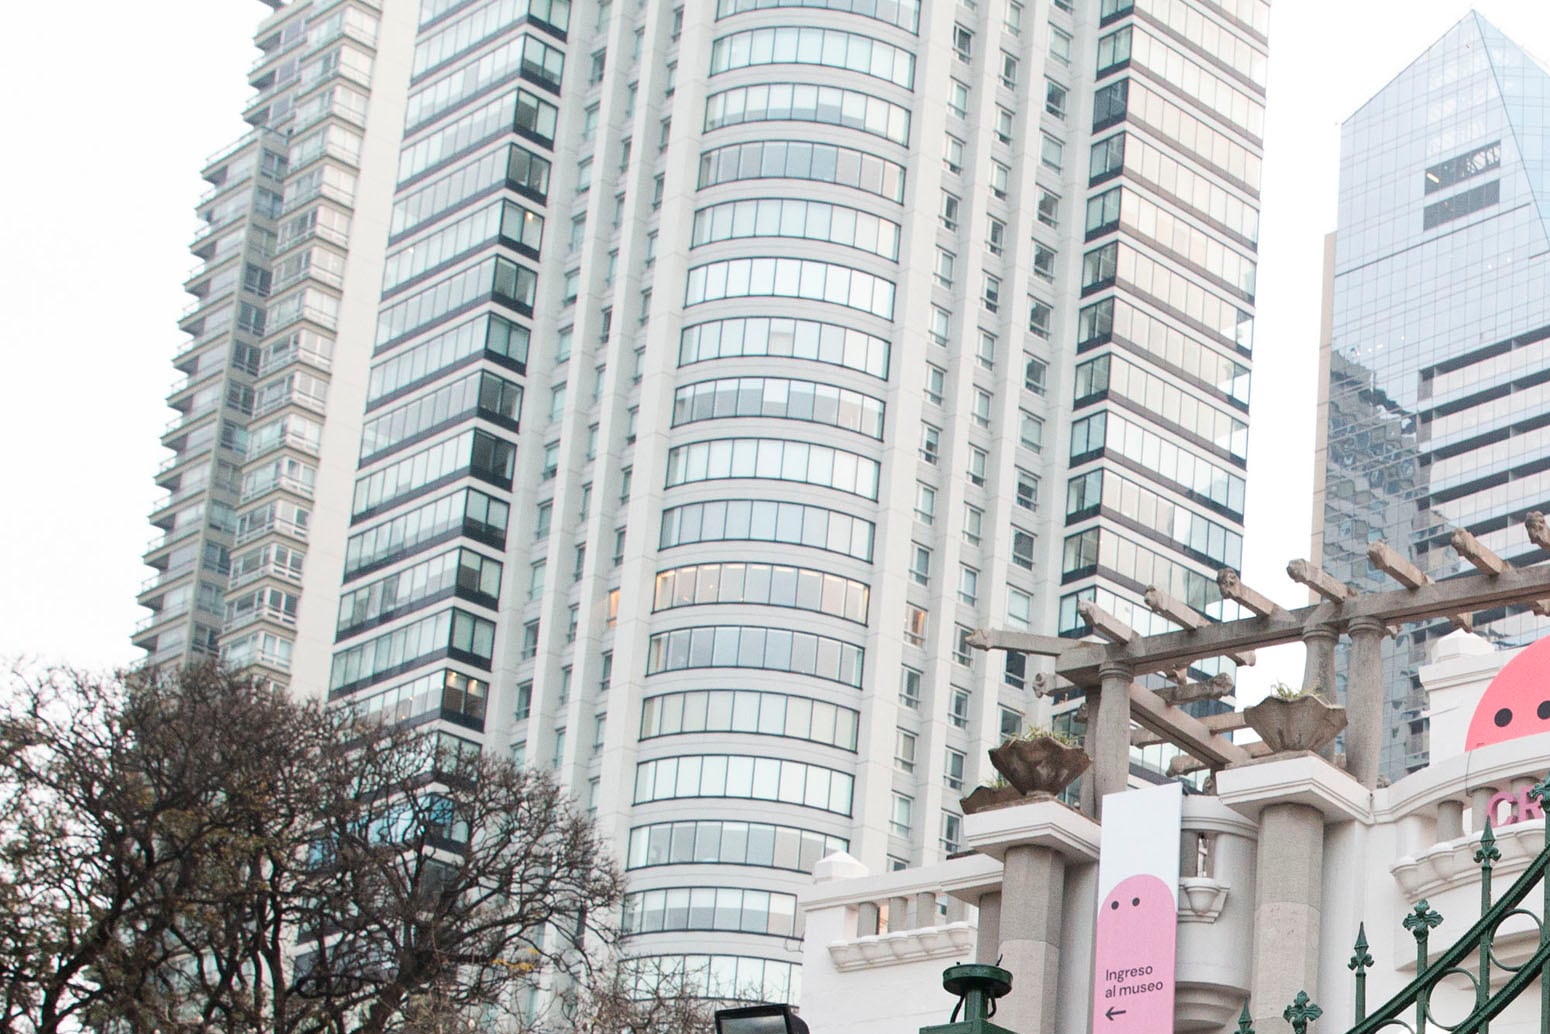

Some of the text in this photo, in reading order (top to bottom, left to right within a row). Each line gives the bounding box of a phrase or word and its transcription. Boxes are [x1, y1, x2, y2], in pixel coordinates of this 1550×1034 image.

[1105, 965, 1153, 982] Ingreso
[1105, 981, 1163, 999] al museo
